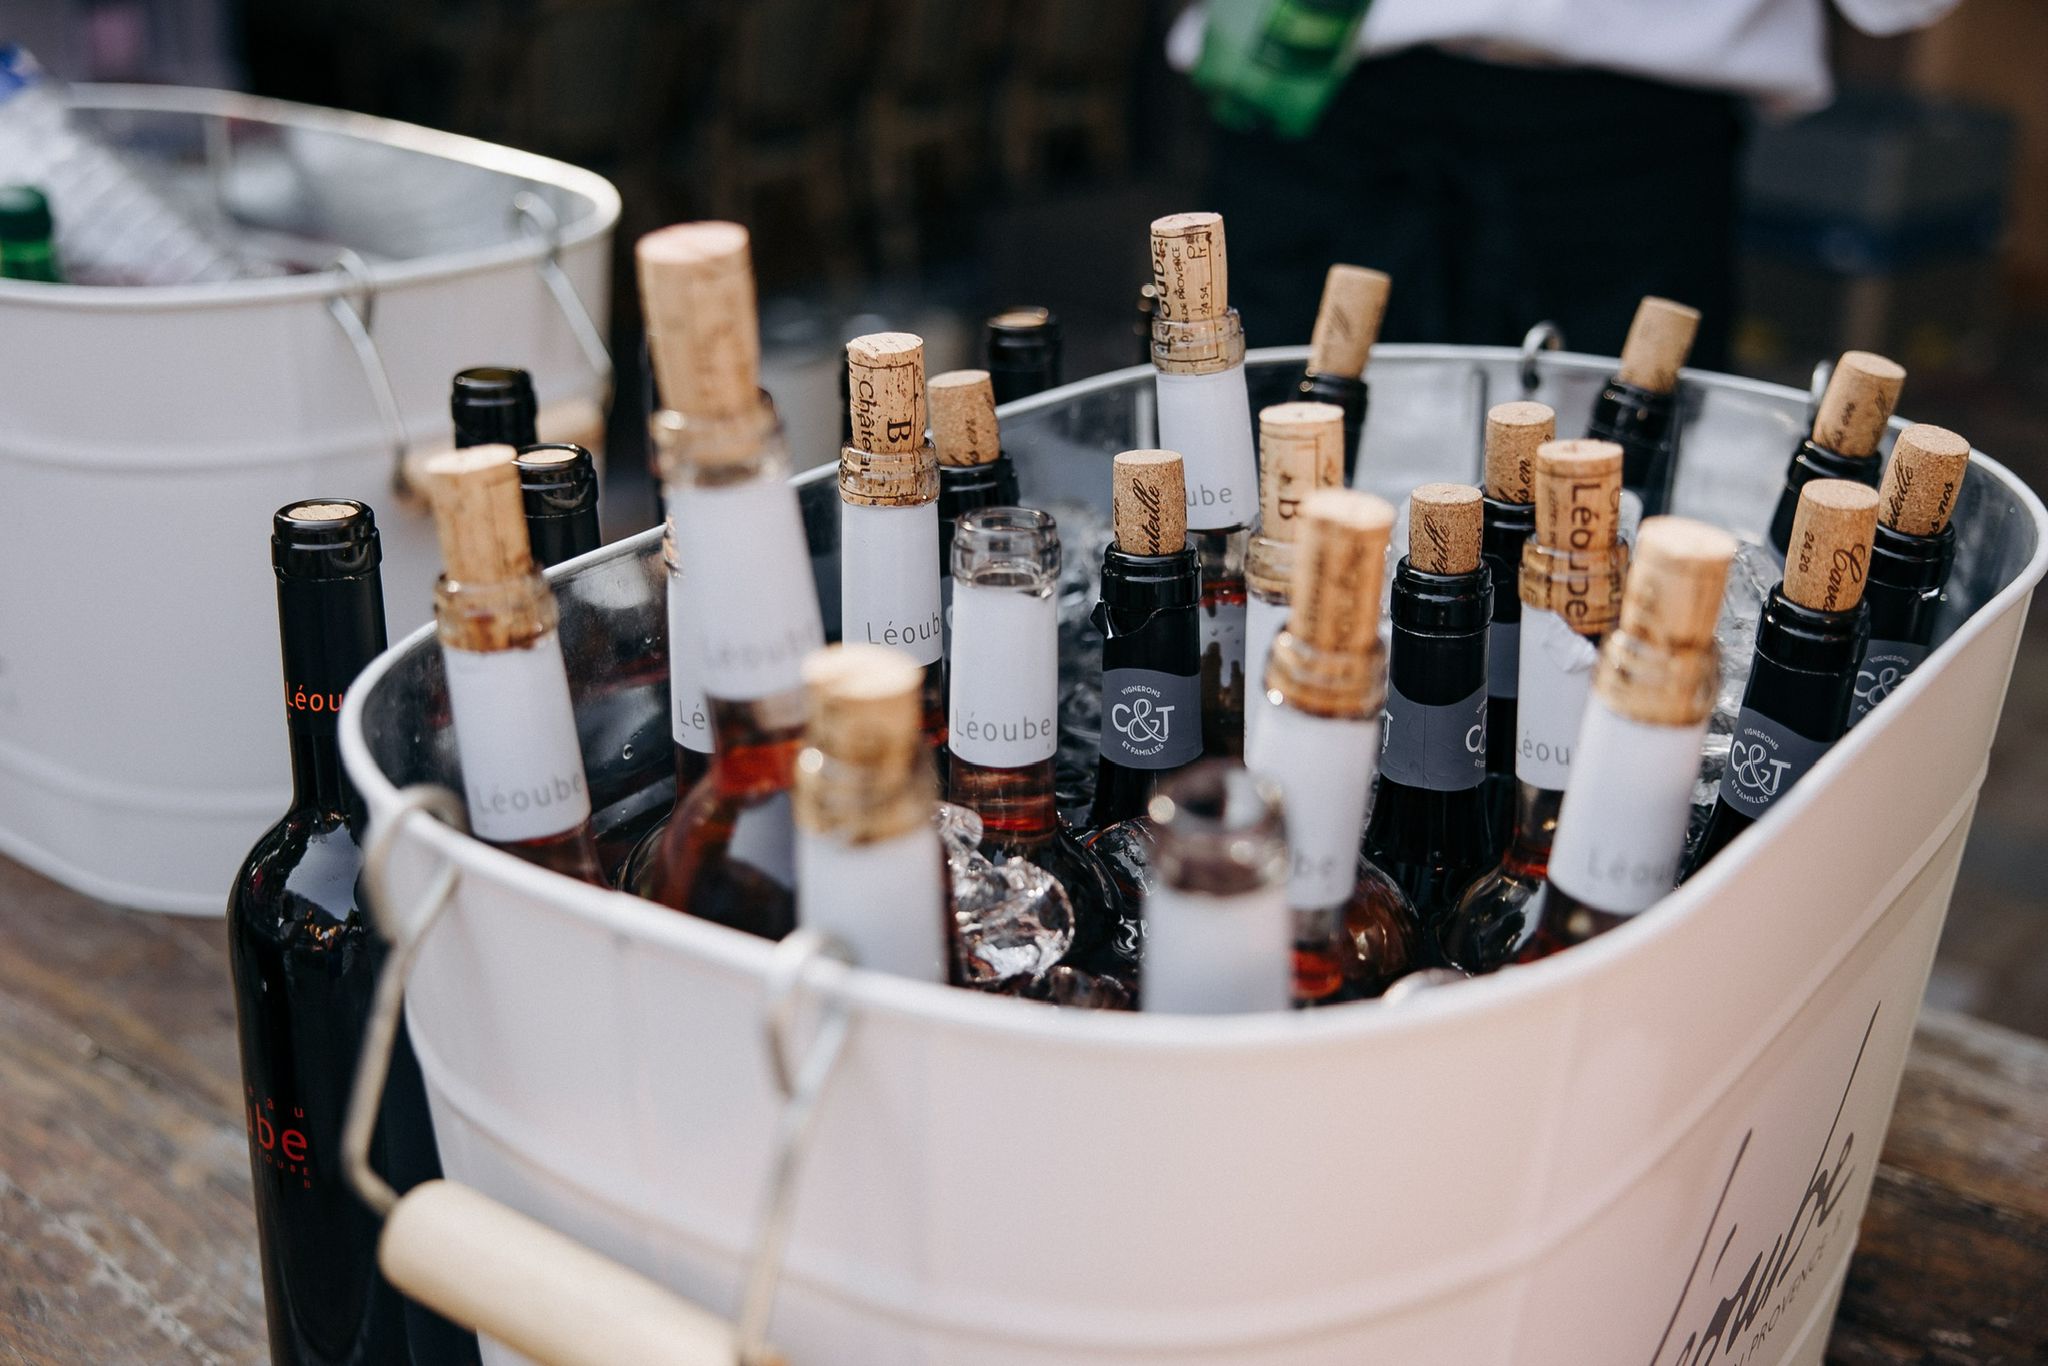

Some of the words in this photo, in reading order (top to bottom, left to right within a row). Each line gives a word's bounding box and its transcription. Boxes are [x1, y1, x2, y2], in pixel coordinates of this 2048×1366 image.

[1171, 246, 1187, 300] PROVENCE
[887, 415, 912, 445] B
[1187, 484, 1232, 507] ube
[1888, 449, 1916, 534] uteille
[1132, 477, 1160, 556] uteille
[1423, 514, 1450, 575] teille
[866, 611, 942, 646] Léoub
[285, 682, 345, 712] Léou
[1121, 685, 1161, 698] VIGNERONS
[956, 708, 1051, 742] Léoube
[1111, 698, 1175, 742] C&T
[1130, 743, 1164, 756] FAMILLES
[1743, 727, 1779, 750] VIGNERONS
[1731, 740, 1792, 796] C&T
[1736, 789, 1769, 804] FAMILLES
